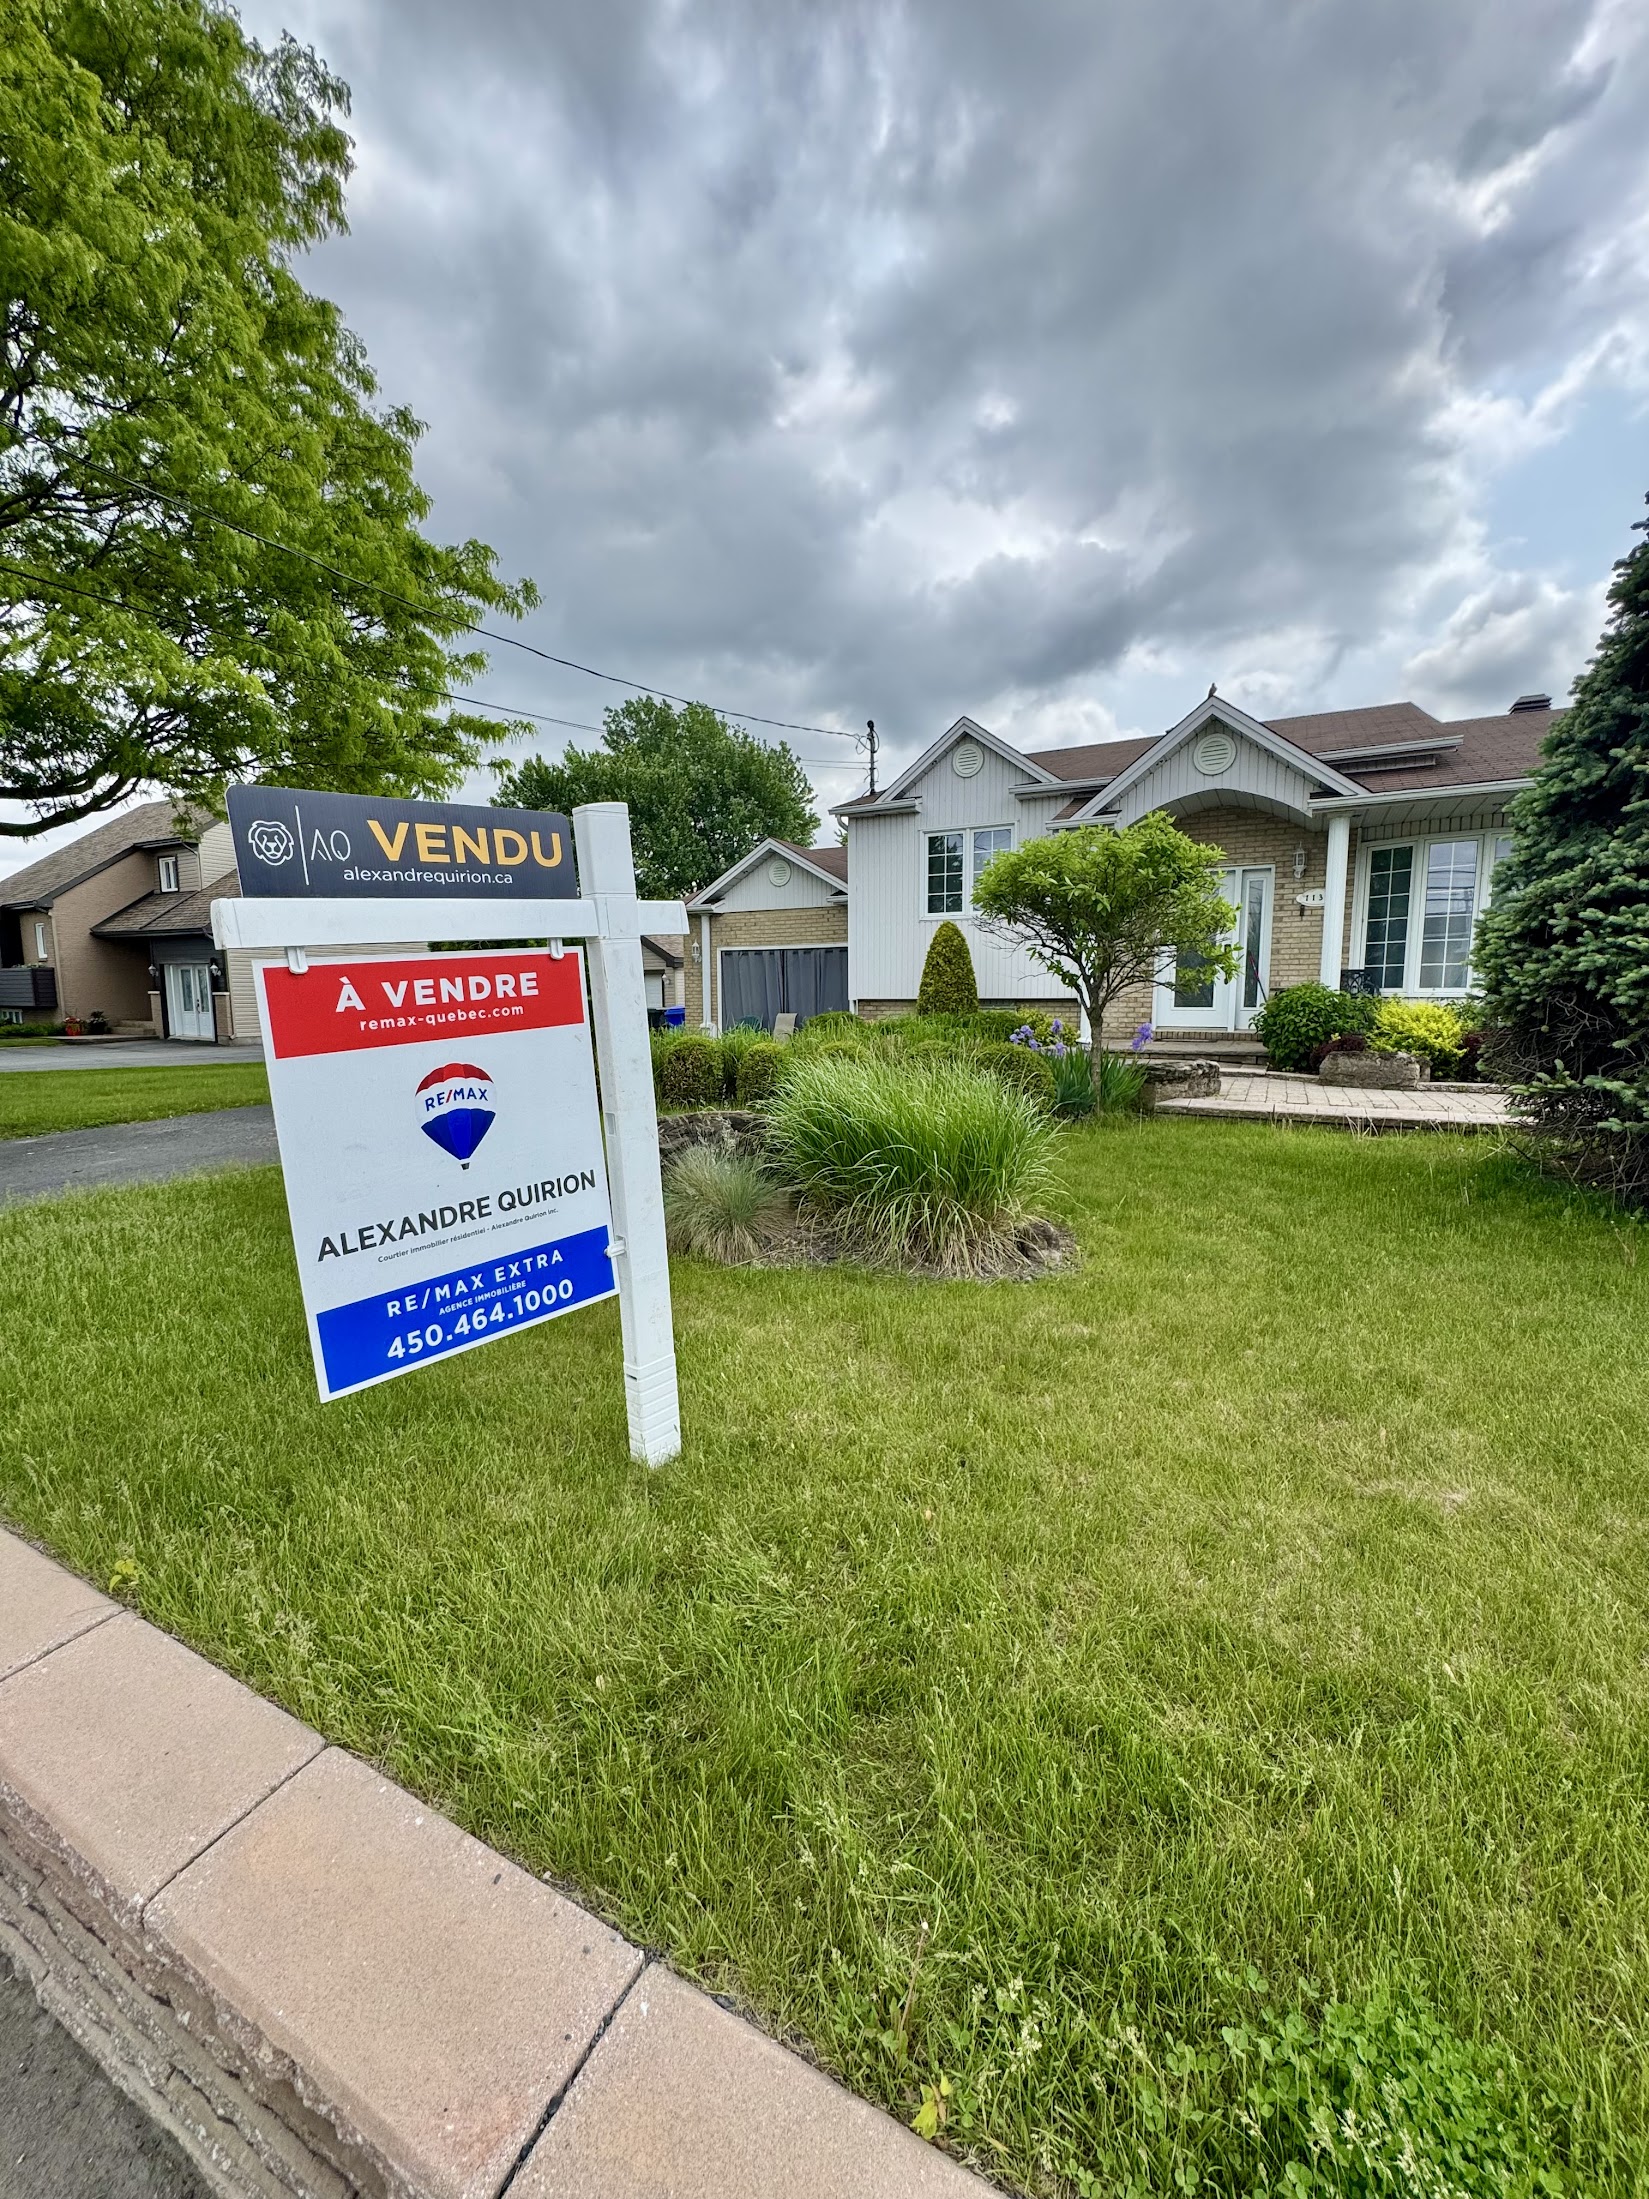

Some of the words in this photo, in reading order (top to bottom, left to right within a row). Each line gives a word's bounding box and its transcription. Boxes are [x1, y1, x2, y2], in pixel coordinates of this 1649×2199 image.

[311, 828, 351, 862] AQ
[367, 819, 564, 867] VENDU
[343, 865, 513, 885] alexandrequirion.ca
[335, 976, 366, 1013] À
[381, 972, 540, 1008] VENDRE
[360, 1004, 524, 1031] remax-quebec.com
[424, 1087, 489, 1112] RE/MAX
[317, 1195, 493, 1263] ALEXANDRE
[498, 1169, 596, 1212] QUIRION
[377, 1249, 409, 1263] Courtier
[410, 1237, 449, 1255] immobilier
[450, 1227, 486, 1244] résidentiel
[491, 1217, 524, 1232] Alexandre
[524, 1210, 547, 1222] Quirion
[386, 1273, 484, 1318] RE/MAX
[494, 1249, 563, 1283] EXTRA
[439, 1298, 473, 1316] AGENCE
[474, 1280, 527, 1304] IMMOBILIÈRE
[386, 1278, 574, 1360] 450.464.1000
